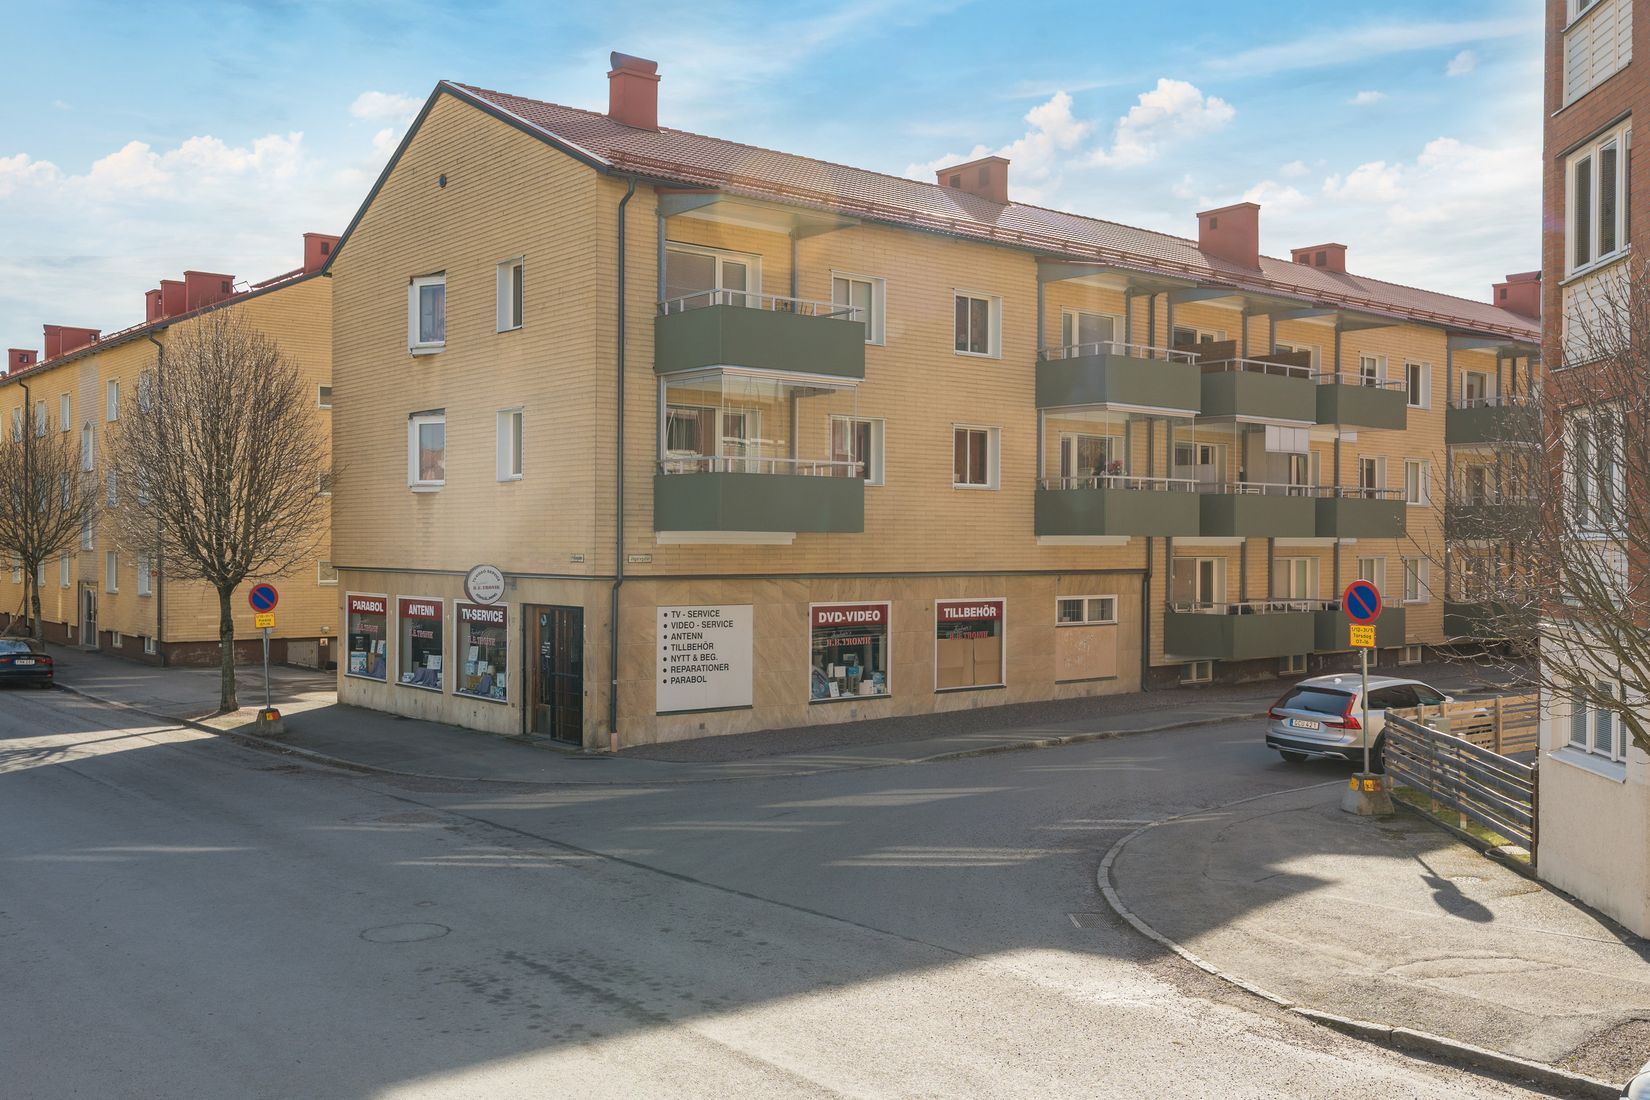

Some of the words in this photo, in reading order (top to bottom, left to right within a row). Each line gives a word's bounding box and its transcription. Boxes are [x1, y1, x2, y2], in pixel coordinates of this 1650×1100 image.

[352, 600, 384, 612] PARABOL
[408, 604, 435, 616] ANTENN
[943, 604, 997, 618] TILLBEHÖR
[462, 608, 504, 623] TV-SERVICE
[687, 610, 720, 618] SERVICE
[818, 610, 880, 623] DVD-VIDEO
[671, 621, 695, 629] VIDEO
[701, 620, 734, 628] SERVICE
[671, 632, 703, 640] ANTENN
[671, 641, 714, 651] TILLBEHÖR
[671, 654, 691, 662] NYTT
[700, 653, 718, 661] BEG.
[670, 663, 729, 673] REPARATIONER
[670, 675, 707, 684] PARABOL
